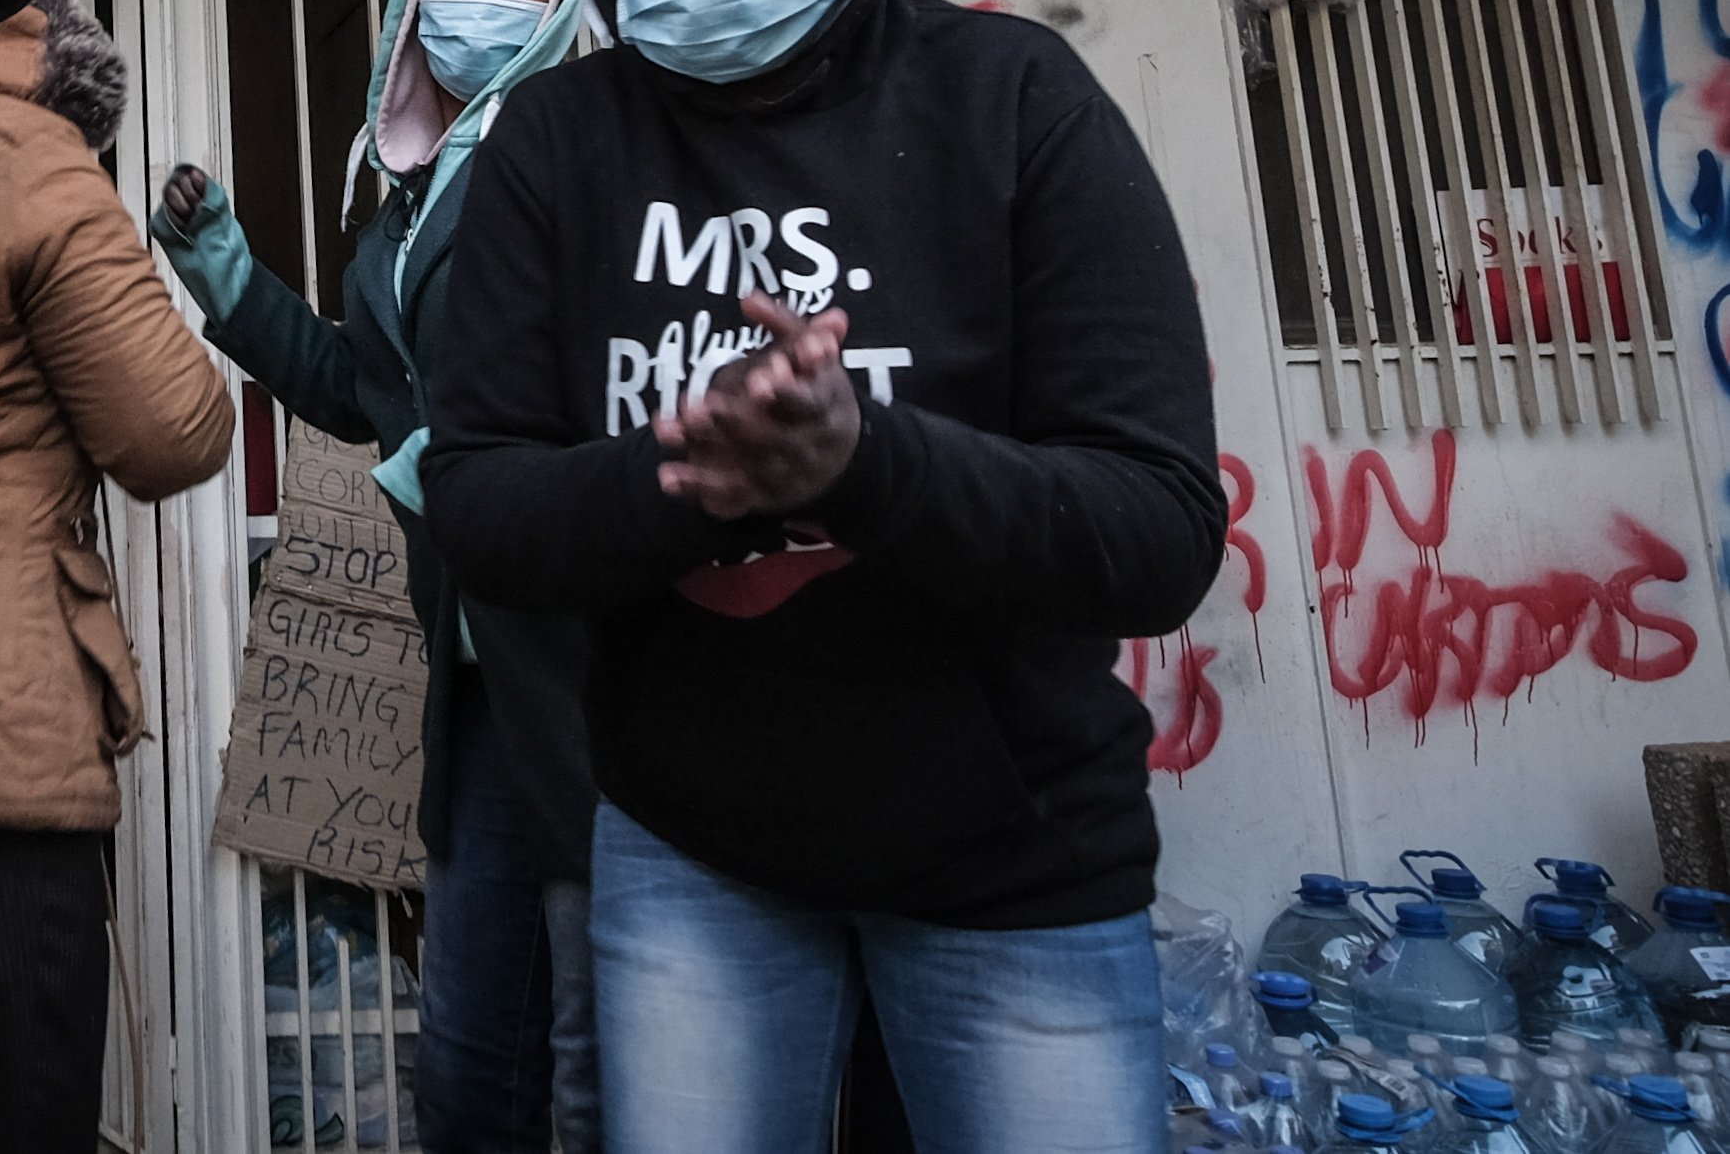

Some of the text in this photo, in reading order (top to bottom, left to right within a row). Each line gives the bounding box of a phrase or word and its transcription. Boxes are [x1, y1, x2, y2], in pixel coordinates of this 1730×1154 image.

[633, 201, 872, 299] MRS.
[285, 533, 397, 589] STOP
[267, 599, 376, 658] GIRLS
[261, 655, 407, 732] BRING
[258, 712, 420, 777] FAMILY
[245, 773, 311, 814] AT
